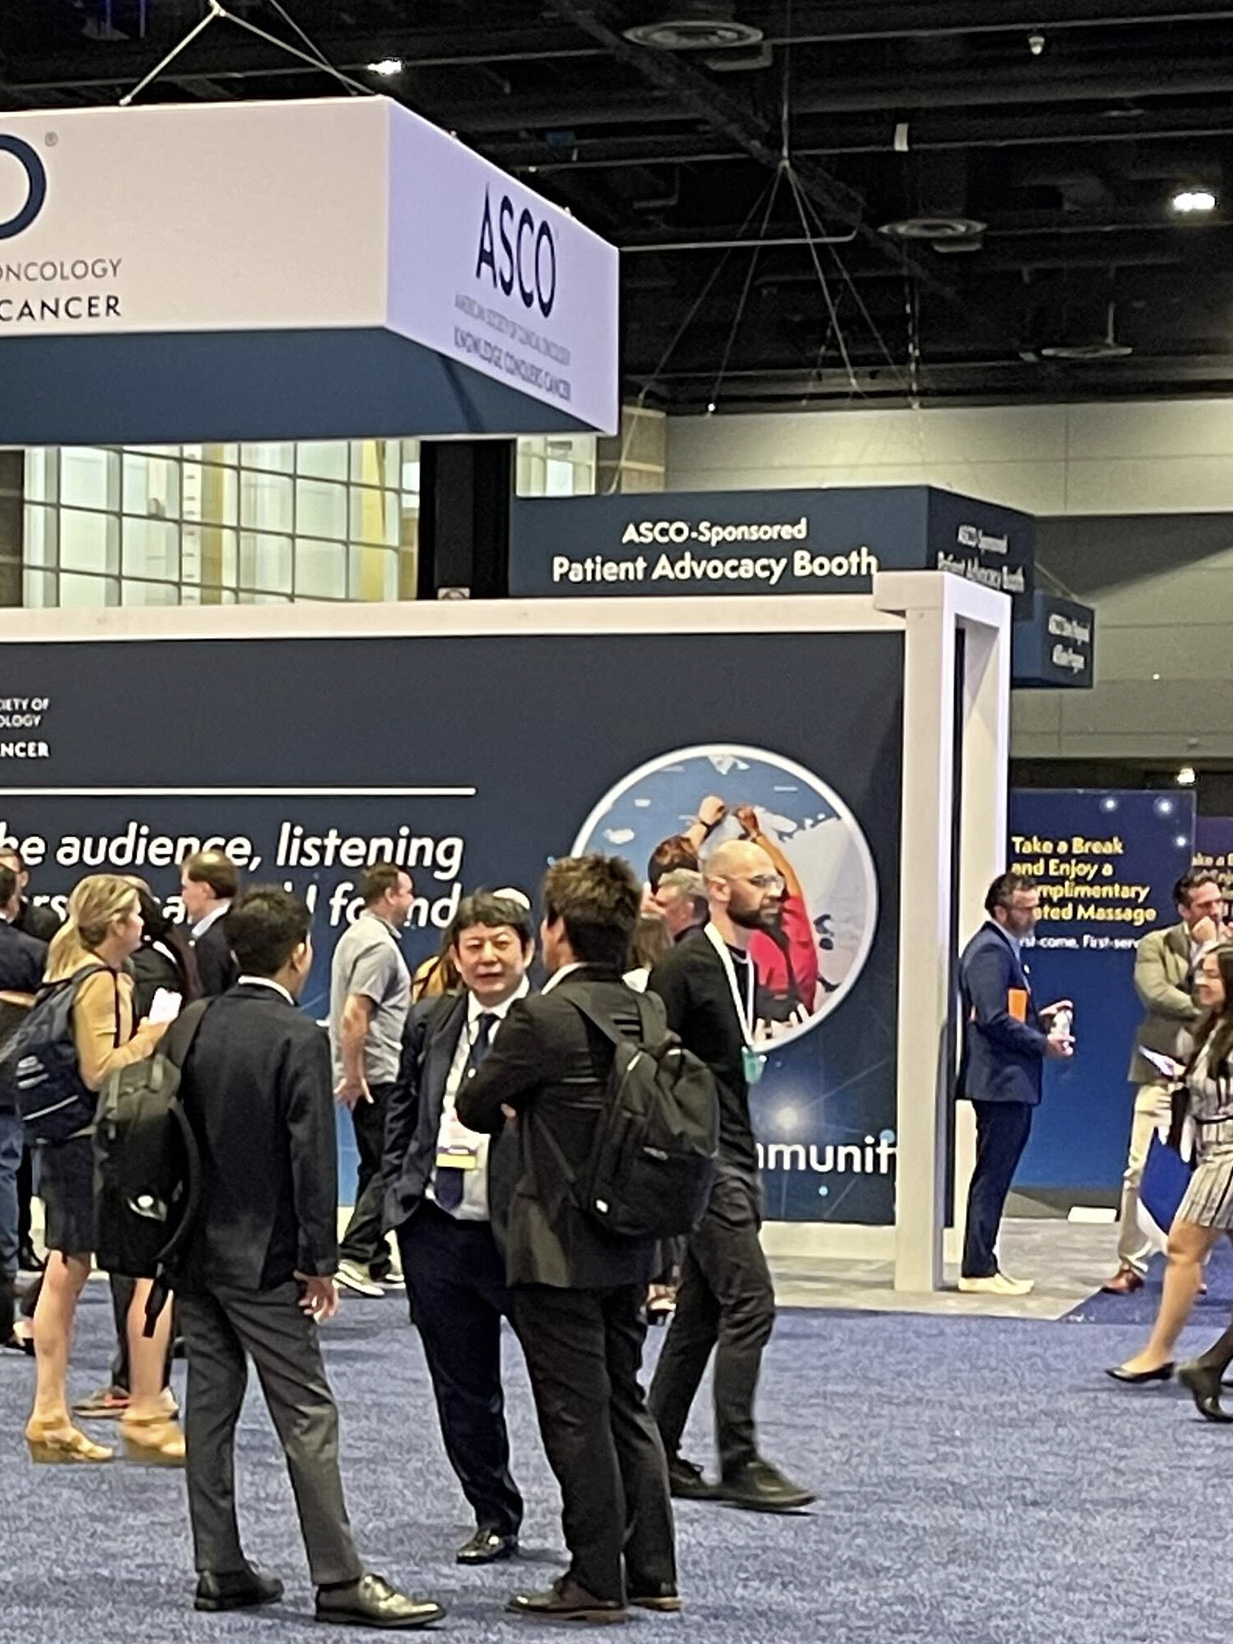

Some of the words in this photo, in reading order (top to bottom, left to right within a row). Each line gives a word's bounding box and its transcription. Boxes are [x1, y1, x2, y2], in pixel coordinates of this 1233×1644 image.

[476, 181, 556, 318] ASCO
[622, 517, 808, 546] ASCO-Sponsored
[553, 555, 647, 582] Patient
[651, 552, 787, 585] Advocacy
[793, 547, 878, 577] Booth
[31, 698, 49, 710] OF
[56, 821, 262, 871] audience,
[276, 821, 464, 880] listening
[1011, 836, 1053, 854] Take
[1057, 841, 1068, 854] a
[1072, 836, 1124, 854] Break
[1011, 858, 1043, 875] and
[1049, 859, 1098, 880] Enjoy
[1102, 864, 1113, 876] a
[1077, 904, 1157, 926] Massage
